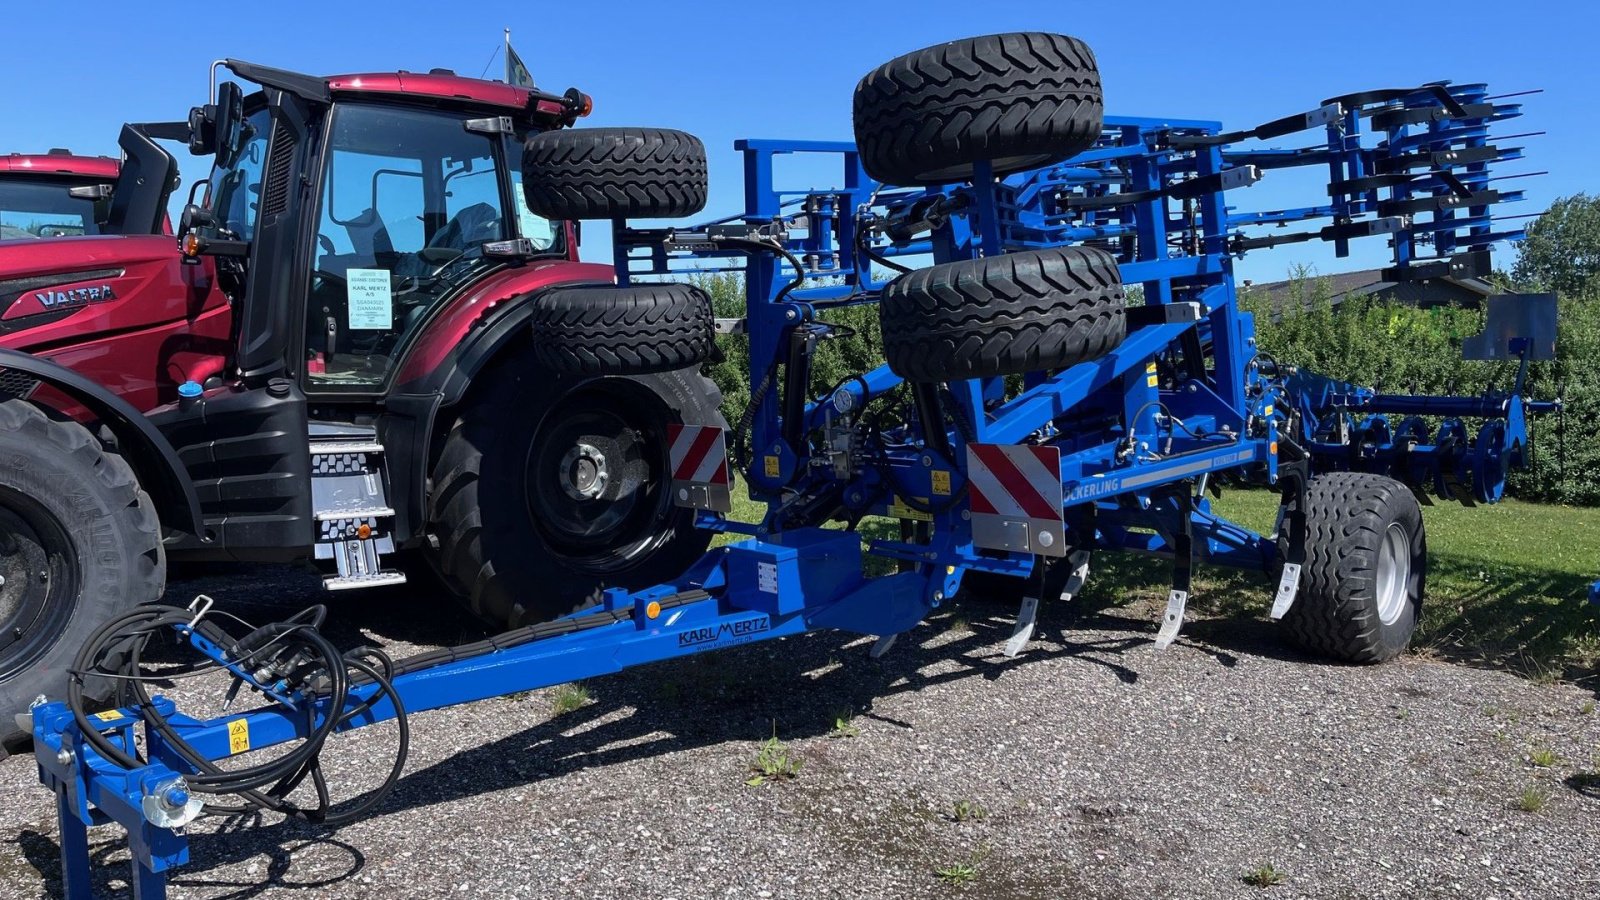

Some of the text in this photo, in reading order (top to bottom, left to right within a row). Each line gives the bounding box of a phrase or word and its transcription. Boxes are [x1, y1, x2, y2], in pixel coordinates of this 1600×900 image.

[35, 285, 117, 309] VALTRA
[1063, 478, 1119, 502] ÖCKERLING
[679, 617, 768, 644] KARL MERTZ
